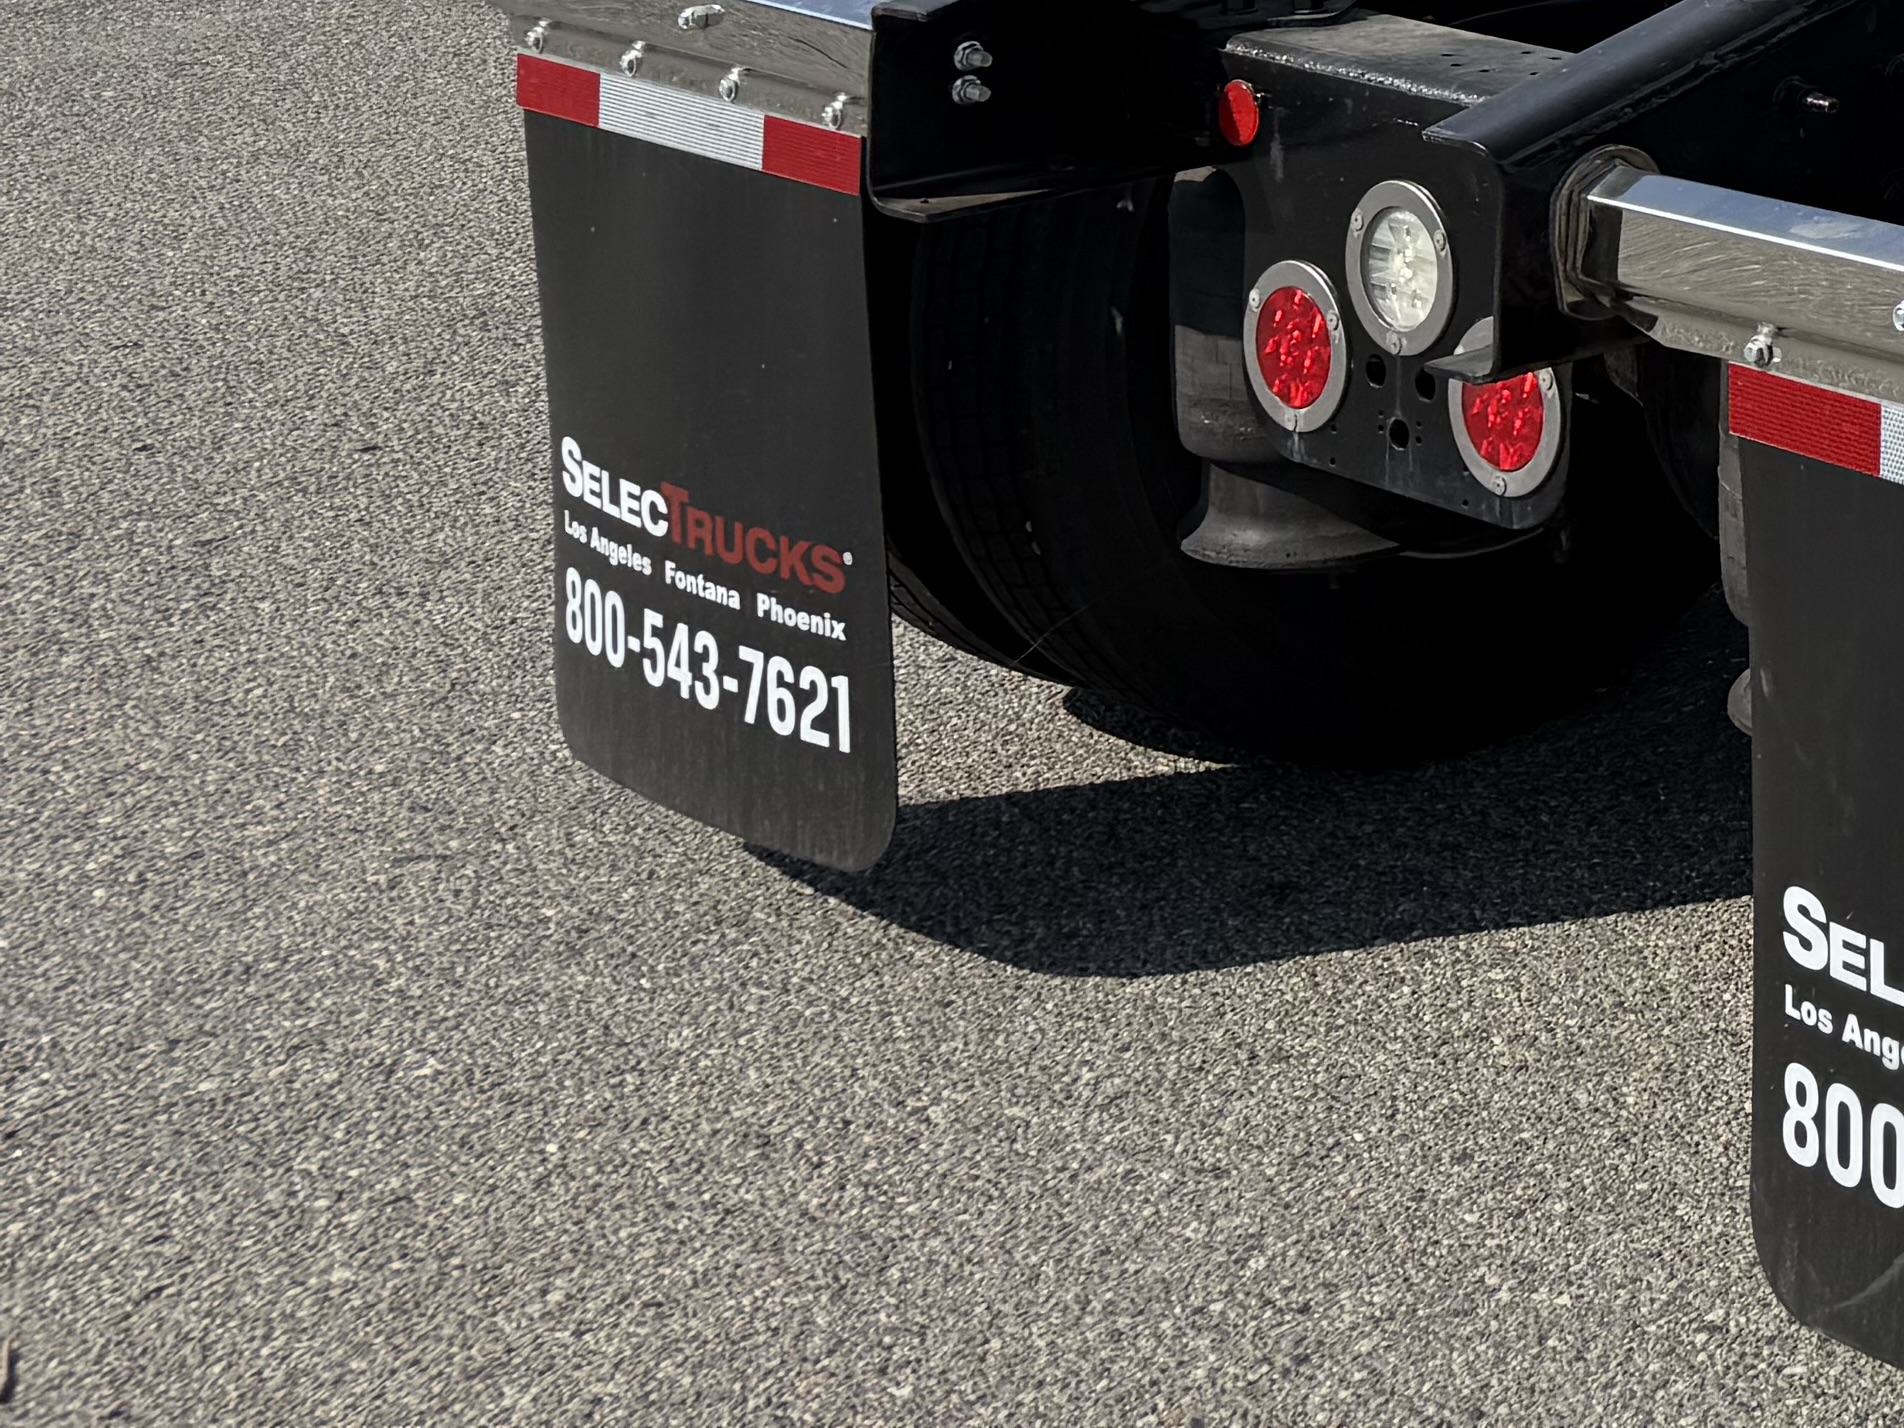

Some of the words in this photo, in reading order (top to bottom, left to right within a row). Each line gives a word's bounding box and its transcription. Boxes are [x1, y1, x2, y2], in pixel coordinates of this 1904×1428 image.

[563, 509, 588, 544] Los
[589, 526, 653, 576] Angeles
[664, 559, 741, 611] Fontana
[756, 592, 847, 642] Phoenix
[565, 566, 851, 754] 800-543-7621
[1784, 983, 1834, 1036] Los
